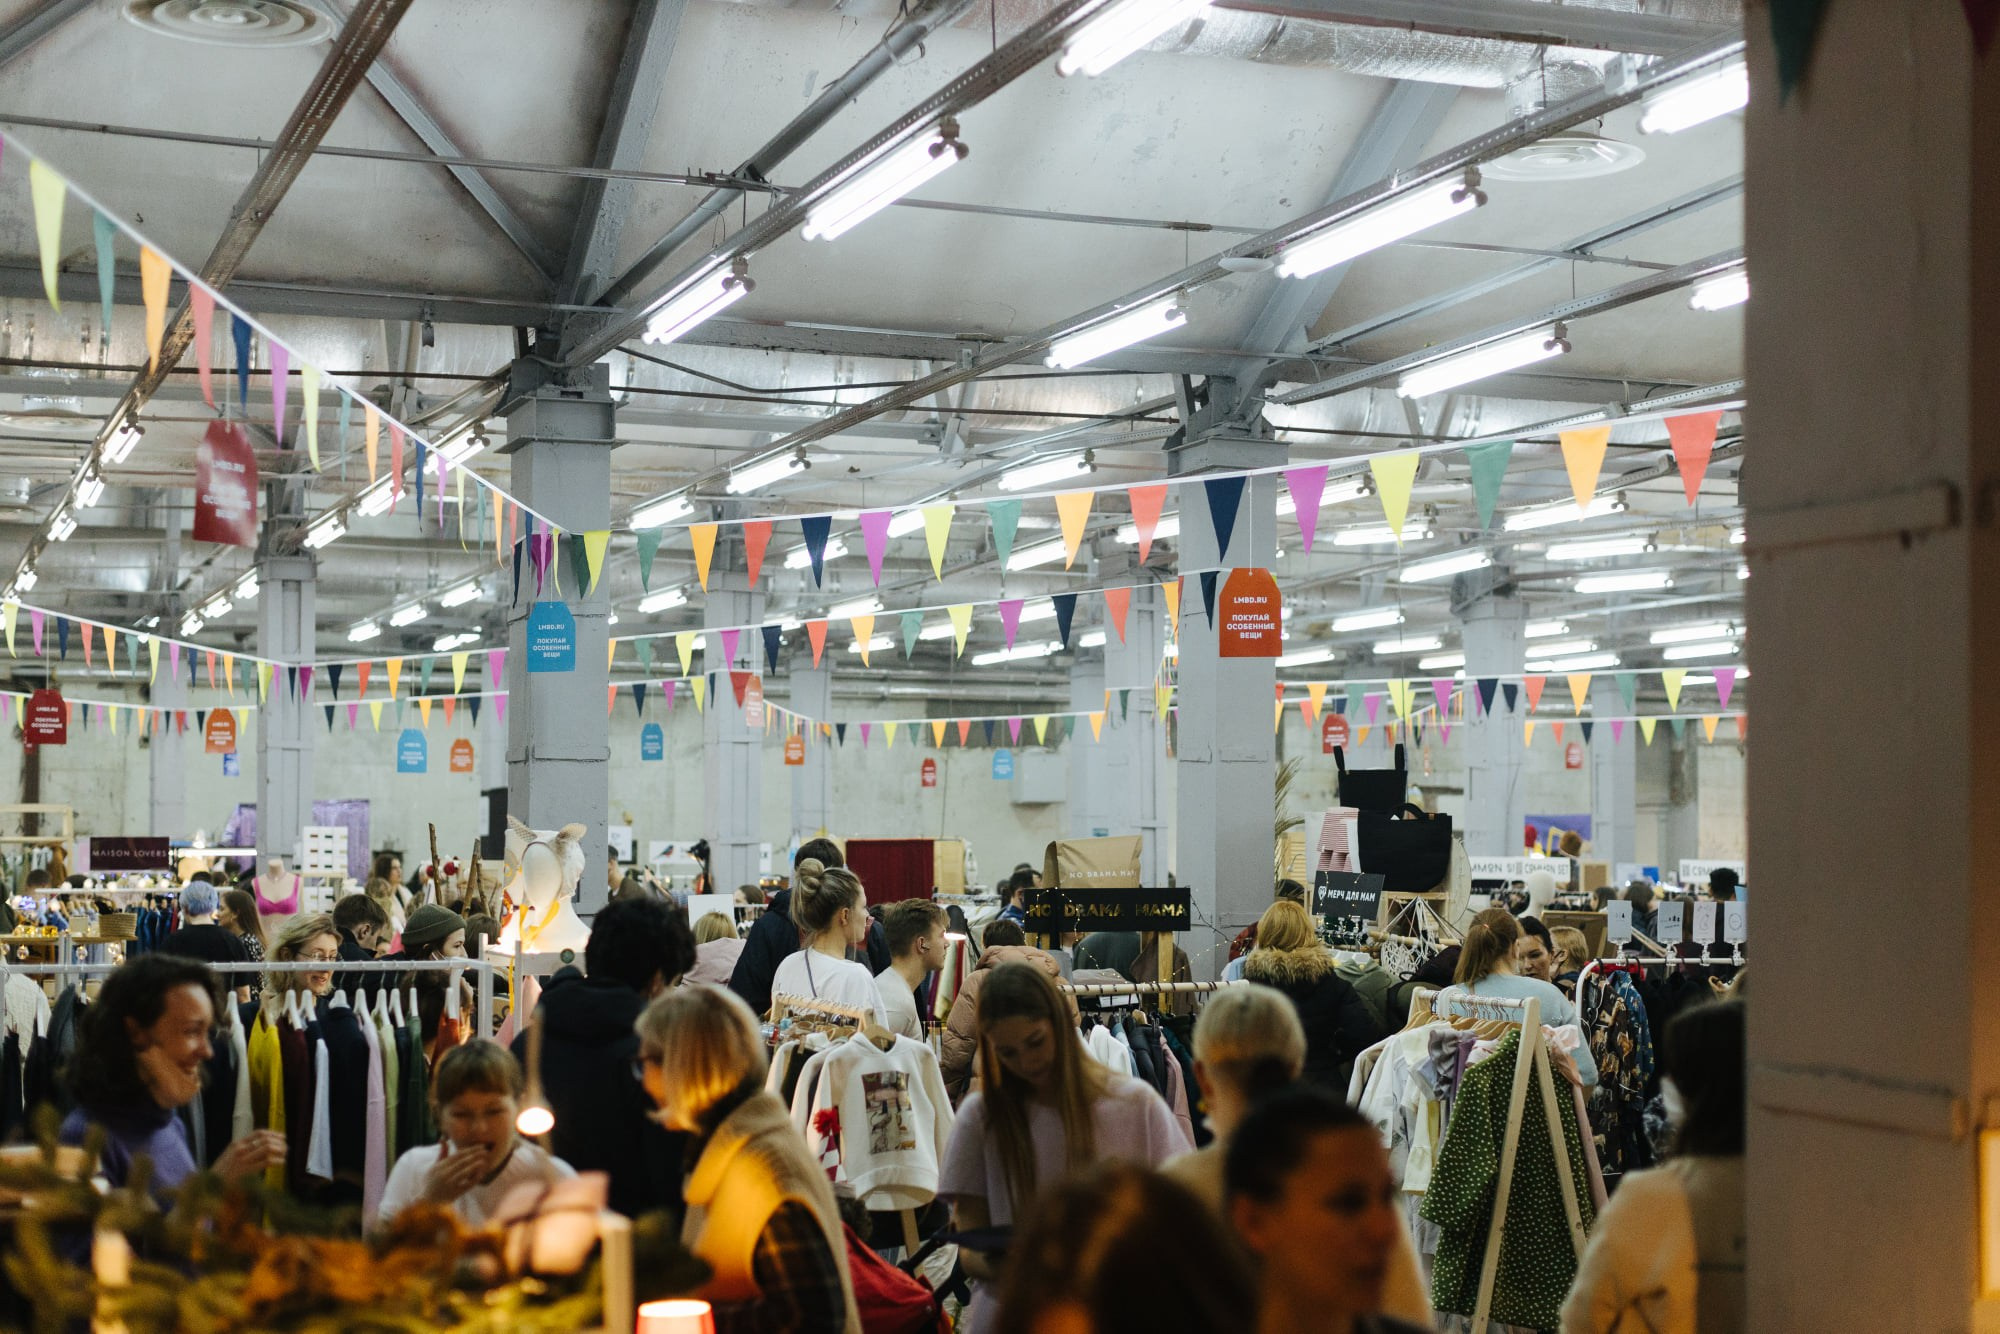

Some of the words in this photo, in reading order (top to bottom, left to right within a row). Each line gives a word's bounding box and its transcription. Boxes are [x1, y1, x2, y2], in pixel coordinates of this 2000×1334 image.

[1233, 596, 1268, 604] LMBD.RU
[1232, 613, 1270, 621] ПОКУПАЙ
[1240, 632, 1262, 640] ВЕЩИ
[92, 849, 130, 857] MAISON
[134, 849, 167, 857] LOVERS
[1069, 871, 1083, 879] NO
[1087, 870, 1117, 878] DRAMA
[1327, 889, 1345, 899] МЕРЧ
[1345, 890, 1360, 902] ДЛЯ
[1360, 891, 1376, 902] МАМ
[1029, 903, 1052, 917] NO
[1063, 903, 1122, 917] DRAMA
[1135, 903, 1188, 917] MAMA
